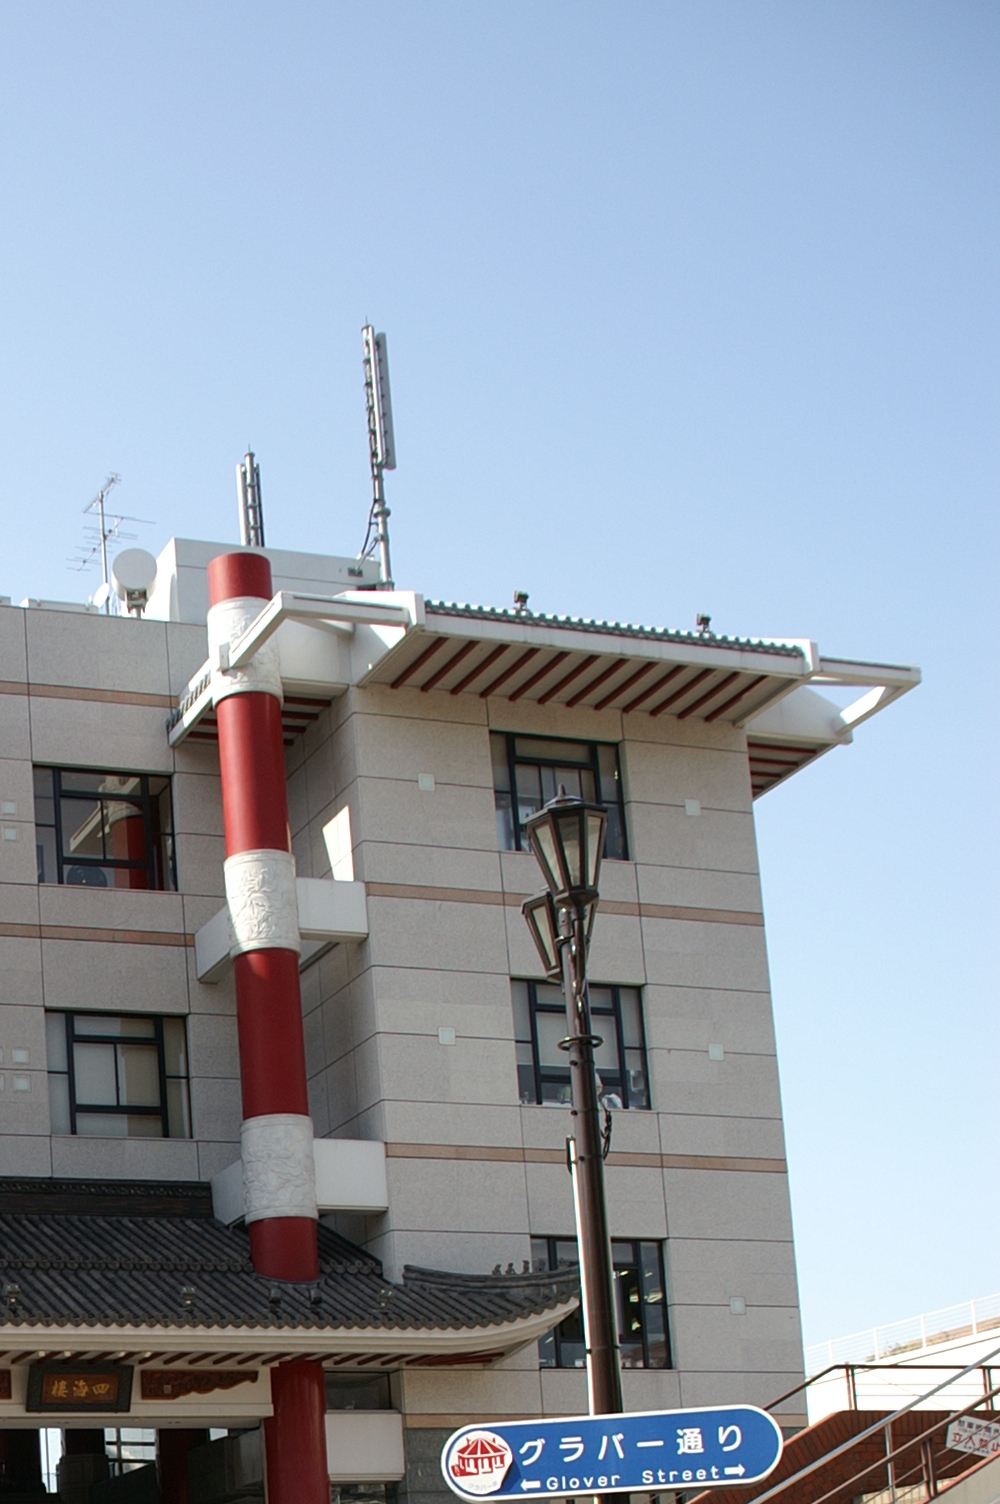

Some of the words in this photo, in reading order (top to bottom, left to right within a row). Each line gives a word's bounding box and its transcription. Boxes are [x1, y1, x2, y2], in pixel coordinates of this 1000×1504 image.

[518, 1424, 743, 1467] グラバー通り
[546, 1472, 621, 1491] Glover
[641, 1465, 720, 1483] Street
